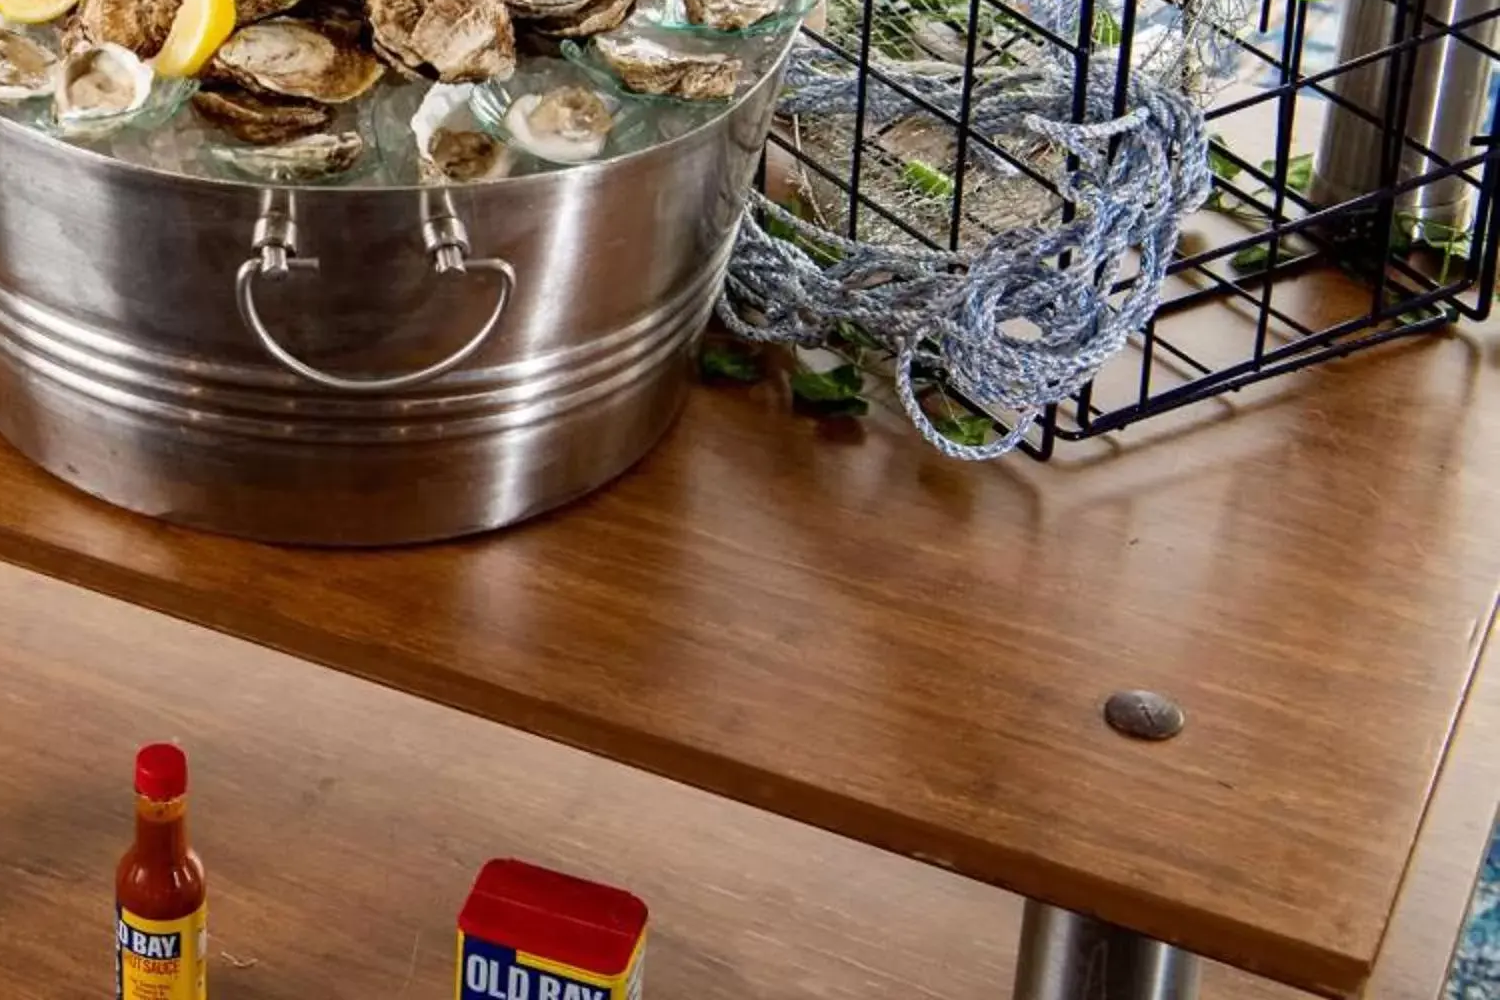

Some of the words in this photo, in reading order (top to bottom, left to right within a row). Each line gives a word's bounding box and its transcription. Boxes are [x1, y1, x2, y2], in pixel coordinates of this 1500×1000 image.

[131, 929, 177, 958] BAY
[466, 953, 531, 1000] OLD
[539, 974, 605, 1000] BA
